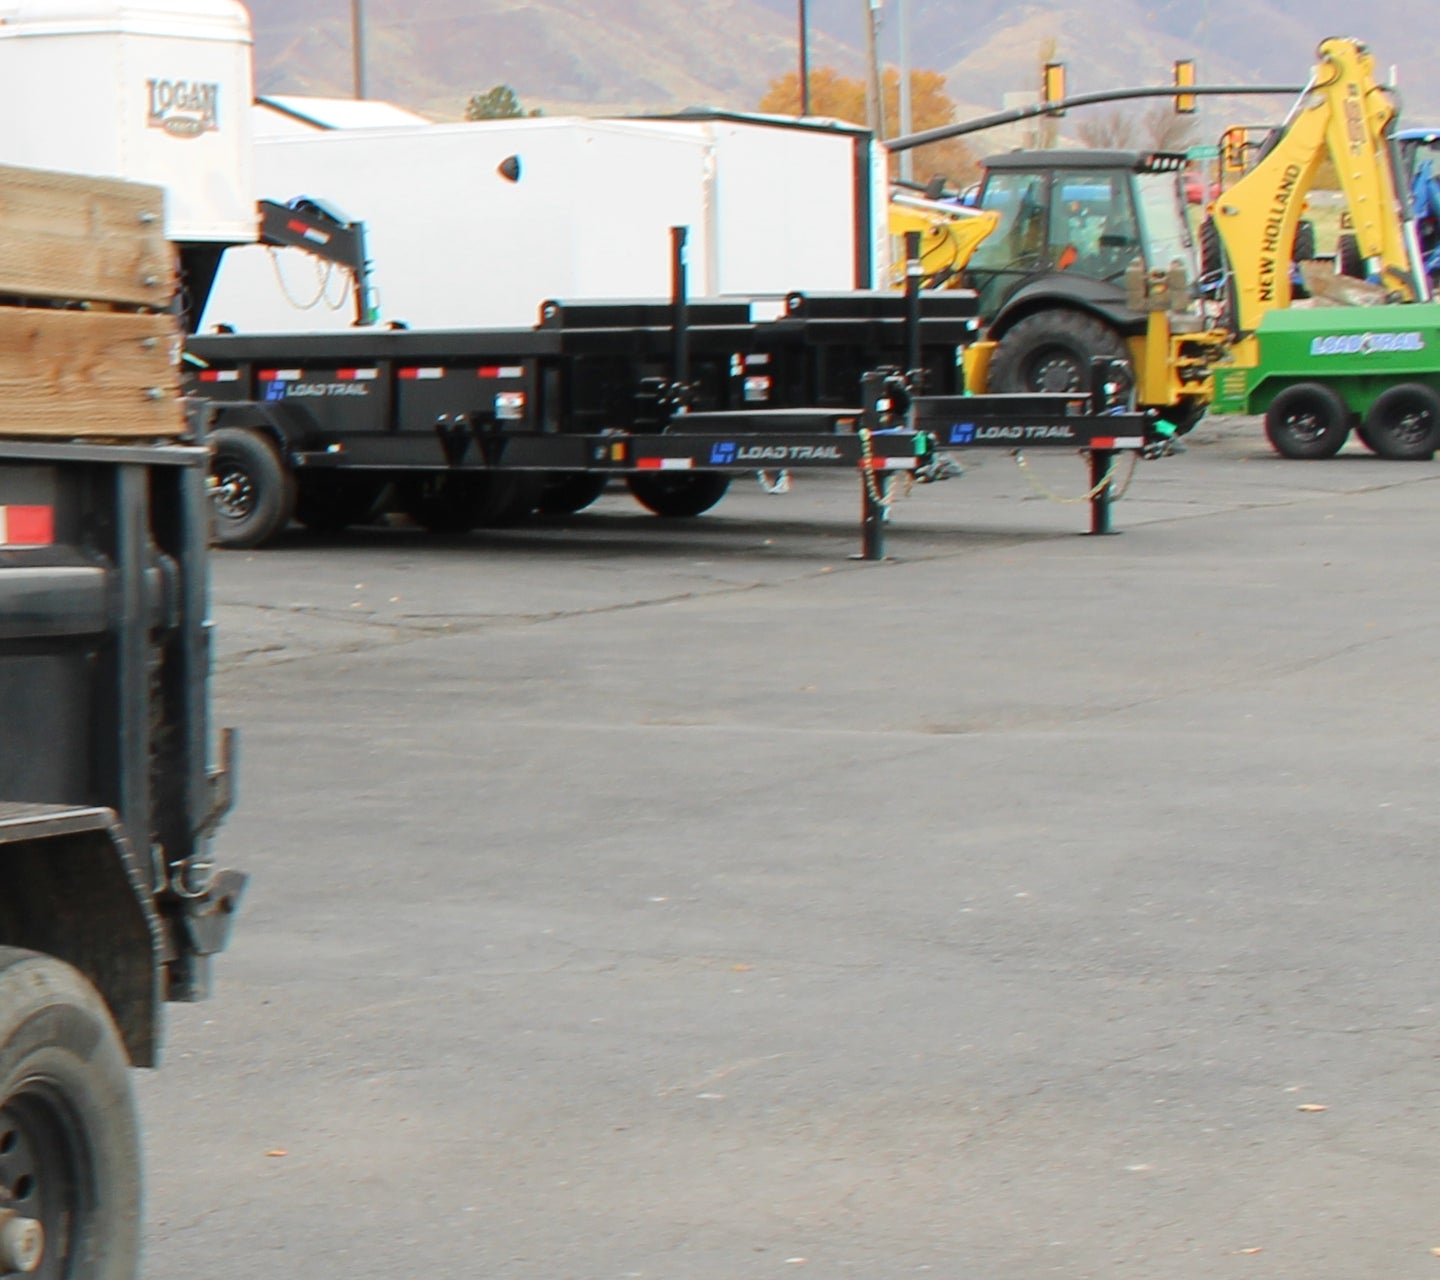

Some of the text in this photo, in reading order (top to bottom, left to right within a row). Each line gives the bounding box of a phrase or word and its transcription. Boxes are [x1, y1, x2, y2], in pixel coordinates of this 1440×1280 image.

[145, 78, 218, 126] LOGAN
[1257, 164, 1300, 302] NEW HOLLAND
